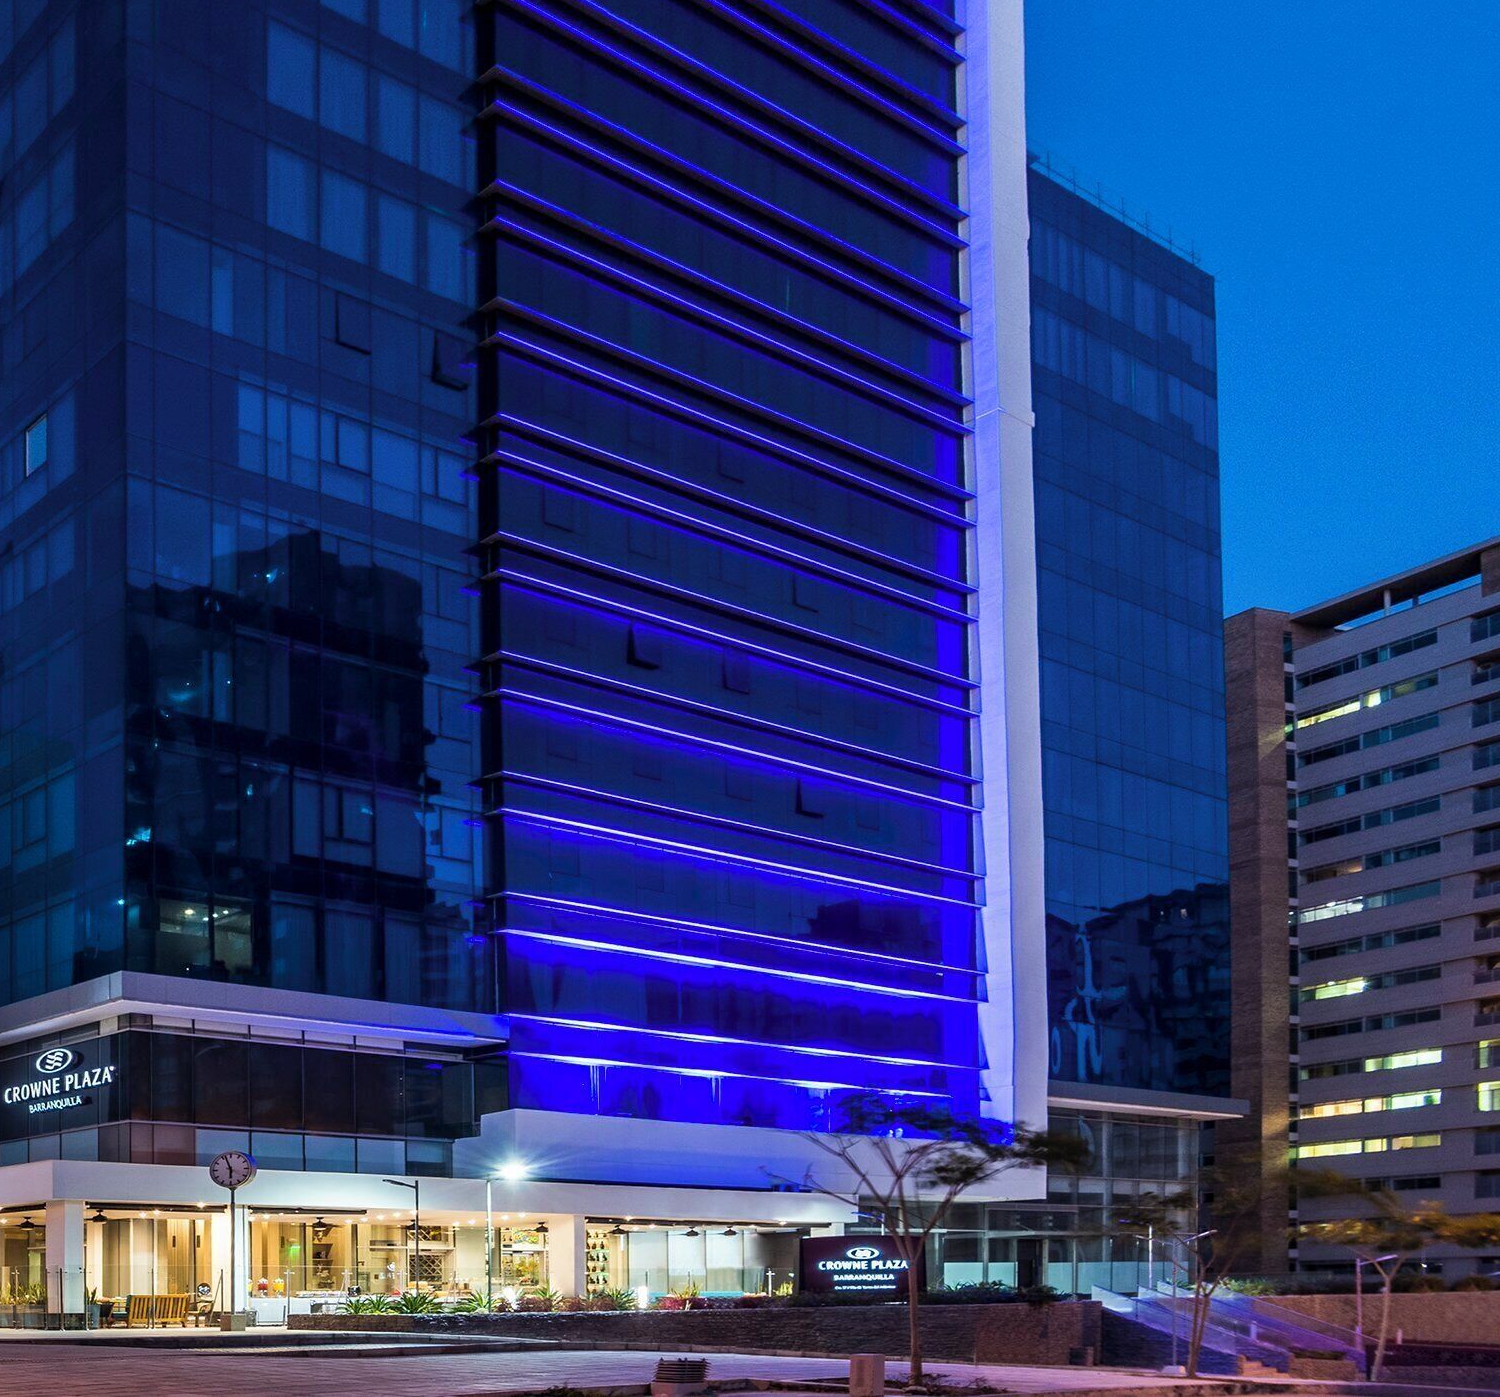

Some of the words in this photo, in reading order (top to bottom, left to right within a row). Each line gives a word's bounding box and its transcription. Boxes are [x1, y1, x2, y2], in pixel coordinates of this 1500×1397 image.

[4, 1077, 60, 1104] CROWNE
[65, 1066, 113, 1092] PLAZA
[28, 1095, 82, 1114] BARRANQUILLA
[818, 1260, 868, 1271] CROWNE
[871, 1259, 909, 1270] PLAZA
[833, 1273, 895, 1281] BARRANQUILLA
